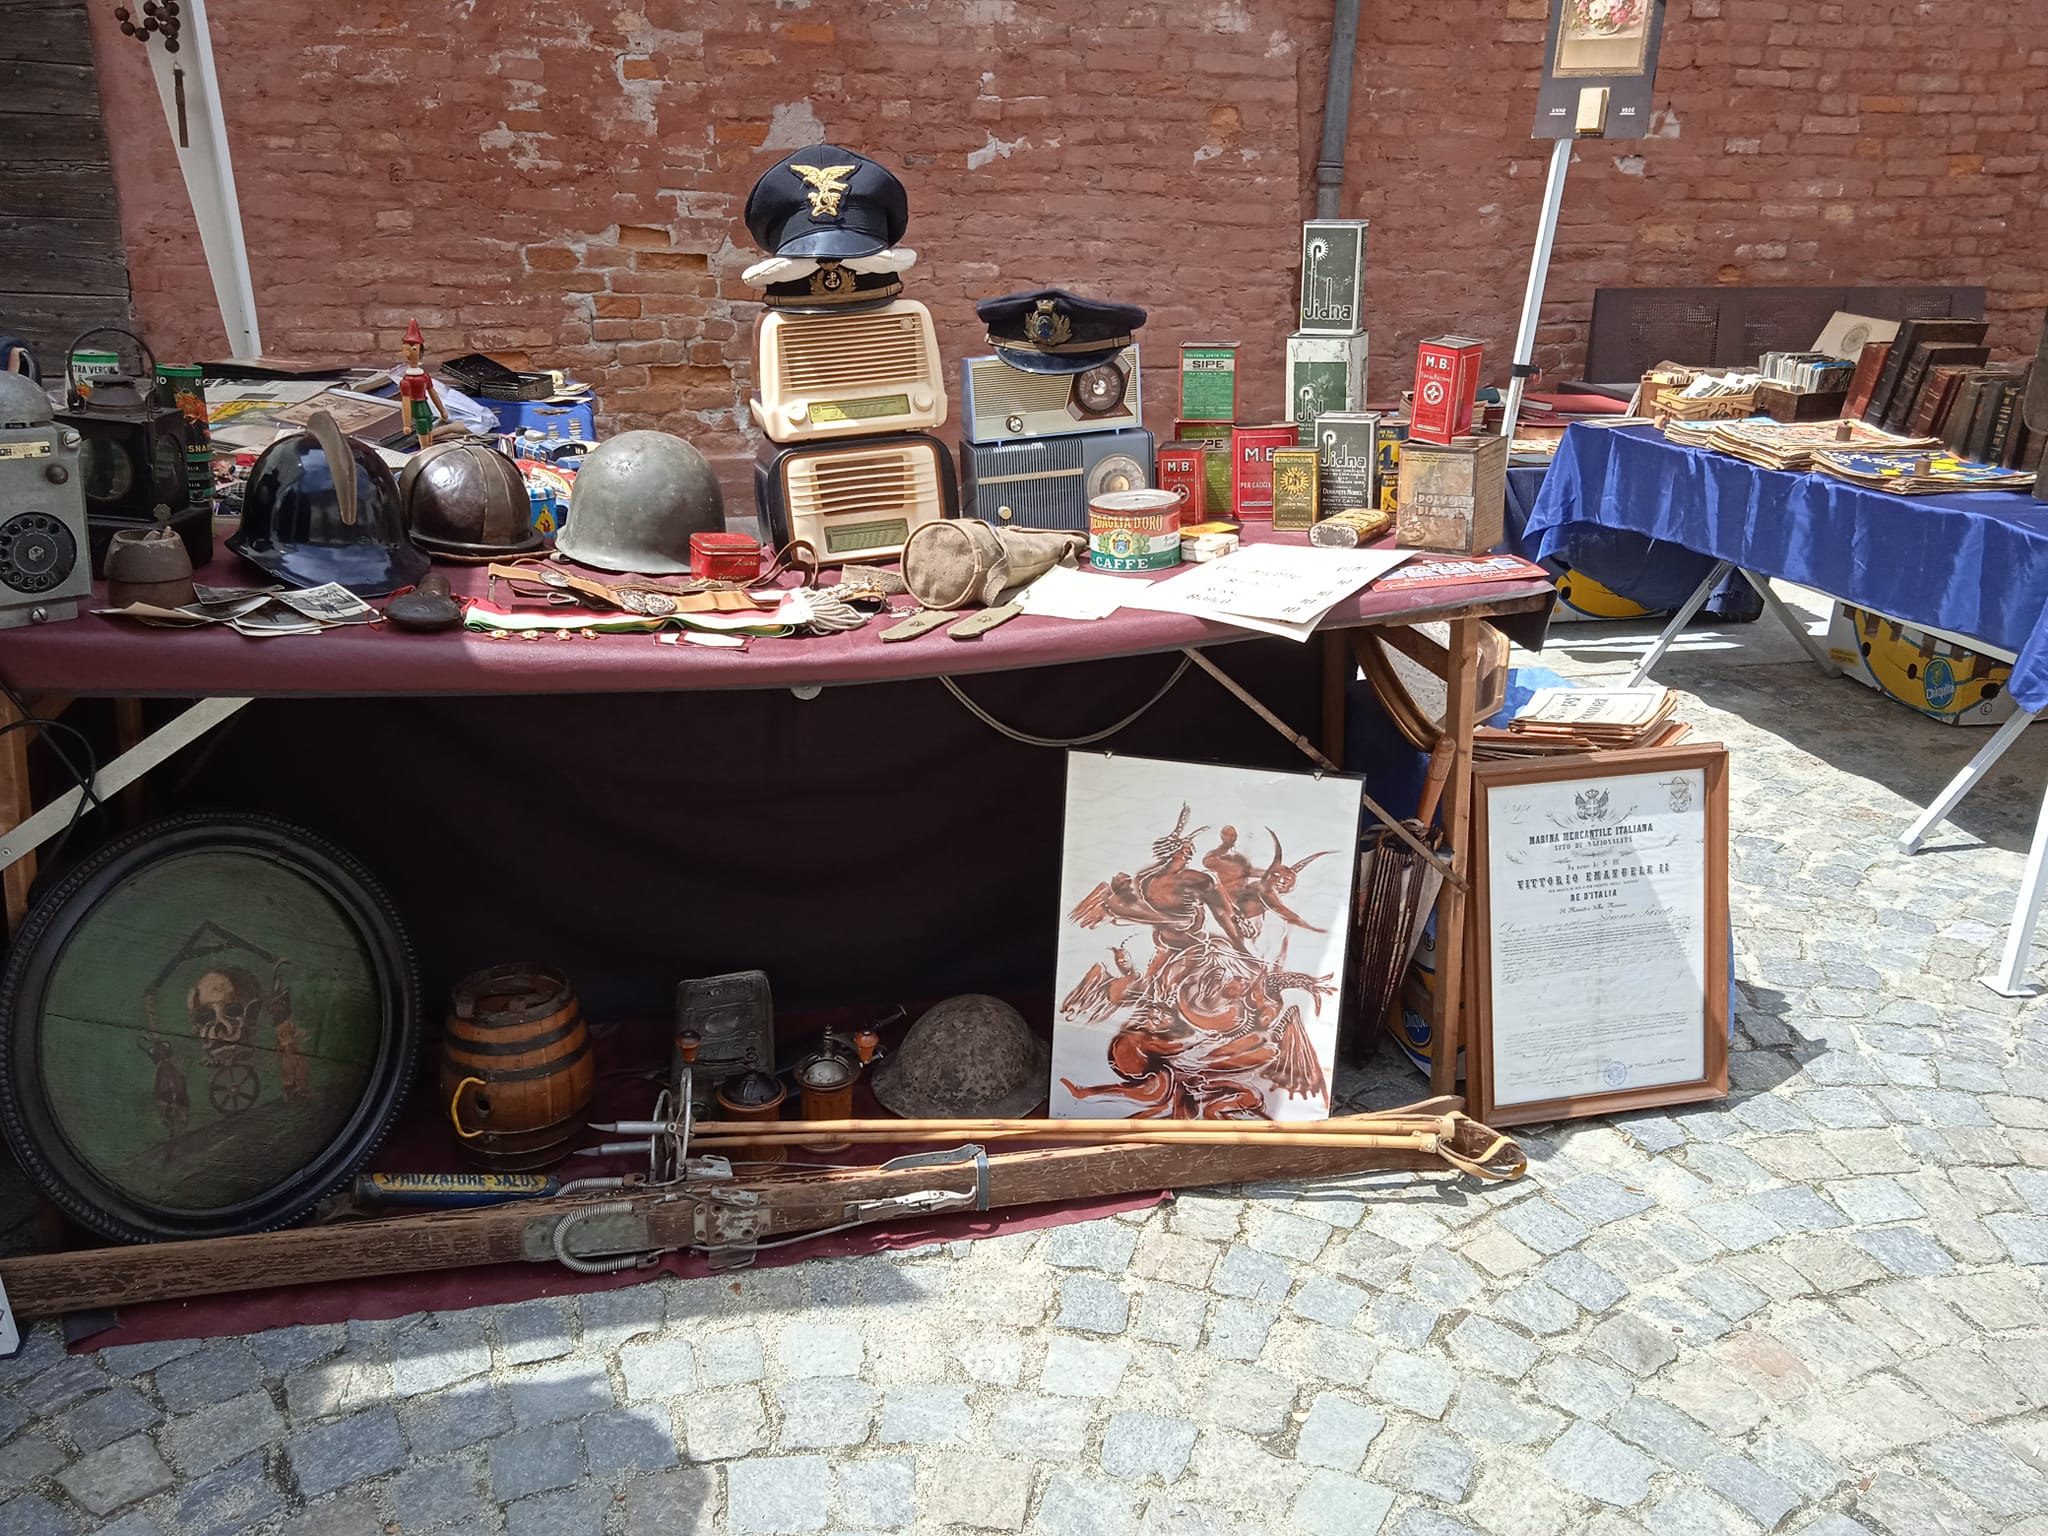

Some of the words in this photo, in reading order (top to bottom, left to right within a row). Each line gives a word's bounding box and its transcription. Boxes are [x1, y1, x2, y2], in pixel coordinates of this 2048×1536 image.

[1193, 360, 1225, 369] SIPE
[1425, 356, 1450, 370] M.B.
[1167, 461, 1193, 472] M.B.
[1133, 514, 1163, 532] D'ORO
[1925, 682, 1956, 702] Chiquita
[1529, 829, 1560, 846] MARINA
[1563, 826, 1612, 842] MERCANTILE
[1615, 822, 1654, 836] ITALIANA
[1517, 872, 1579, 890] VITTORIO
[1586, 864, 1654, 882] EMANUELE
[1659, 862, 1670, 874] II
[1583, 889, 1617, 901] D'ITALIA
[494, 1173, 539, 1187] SALUS
